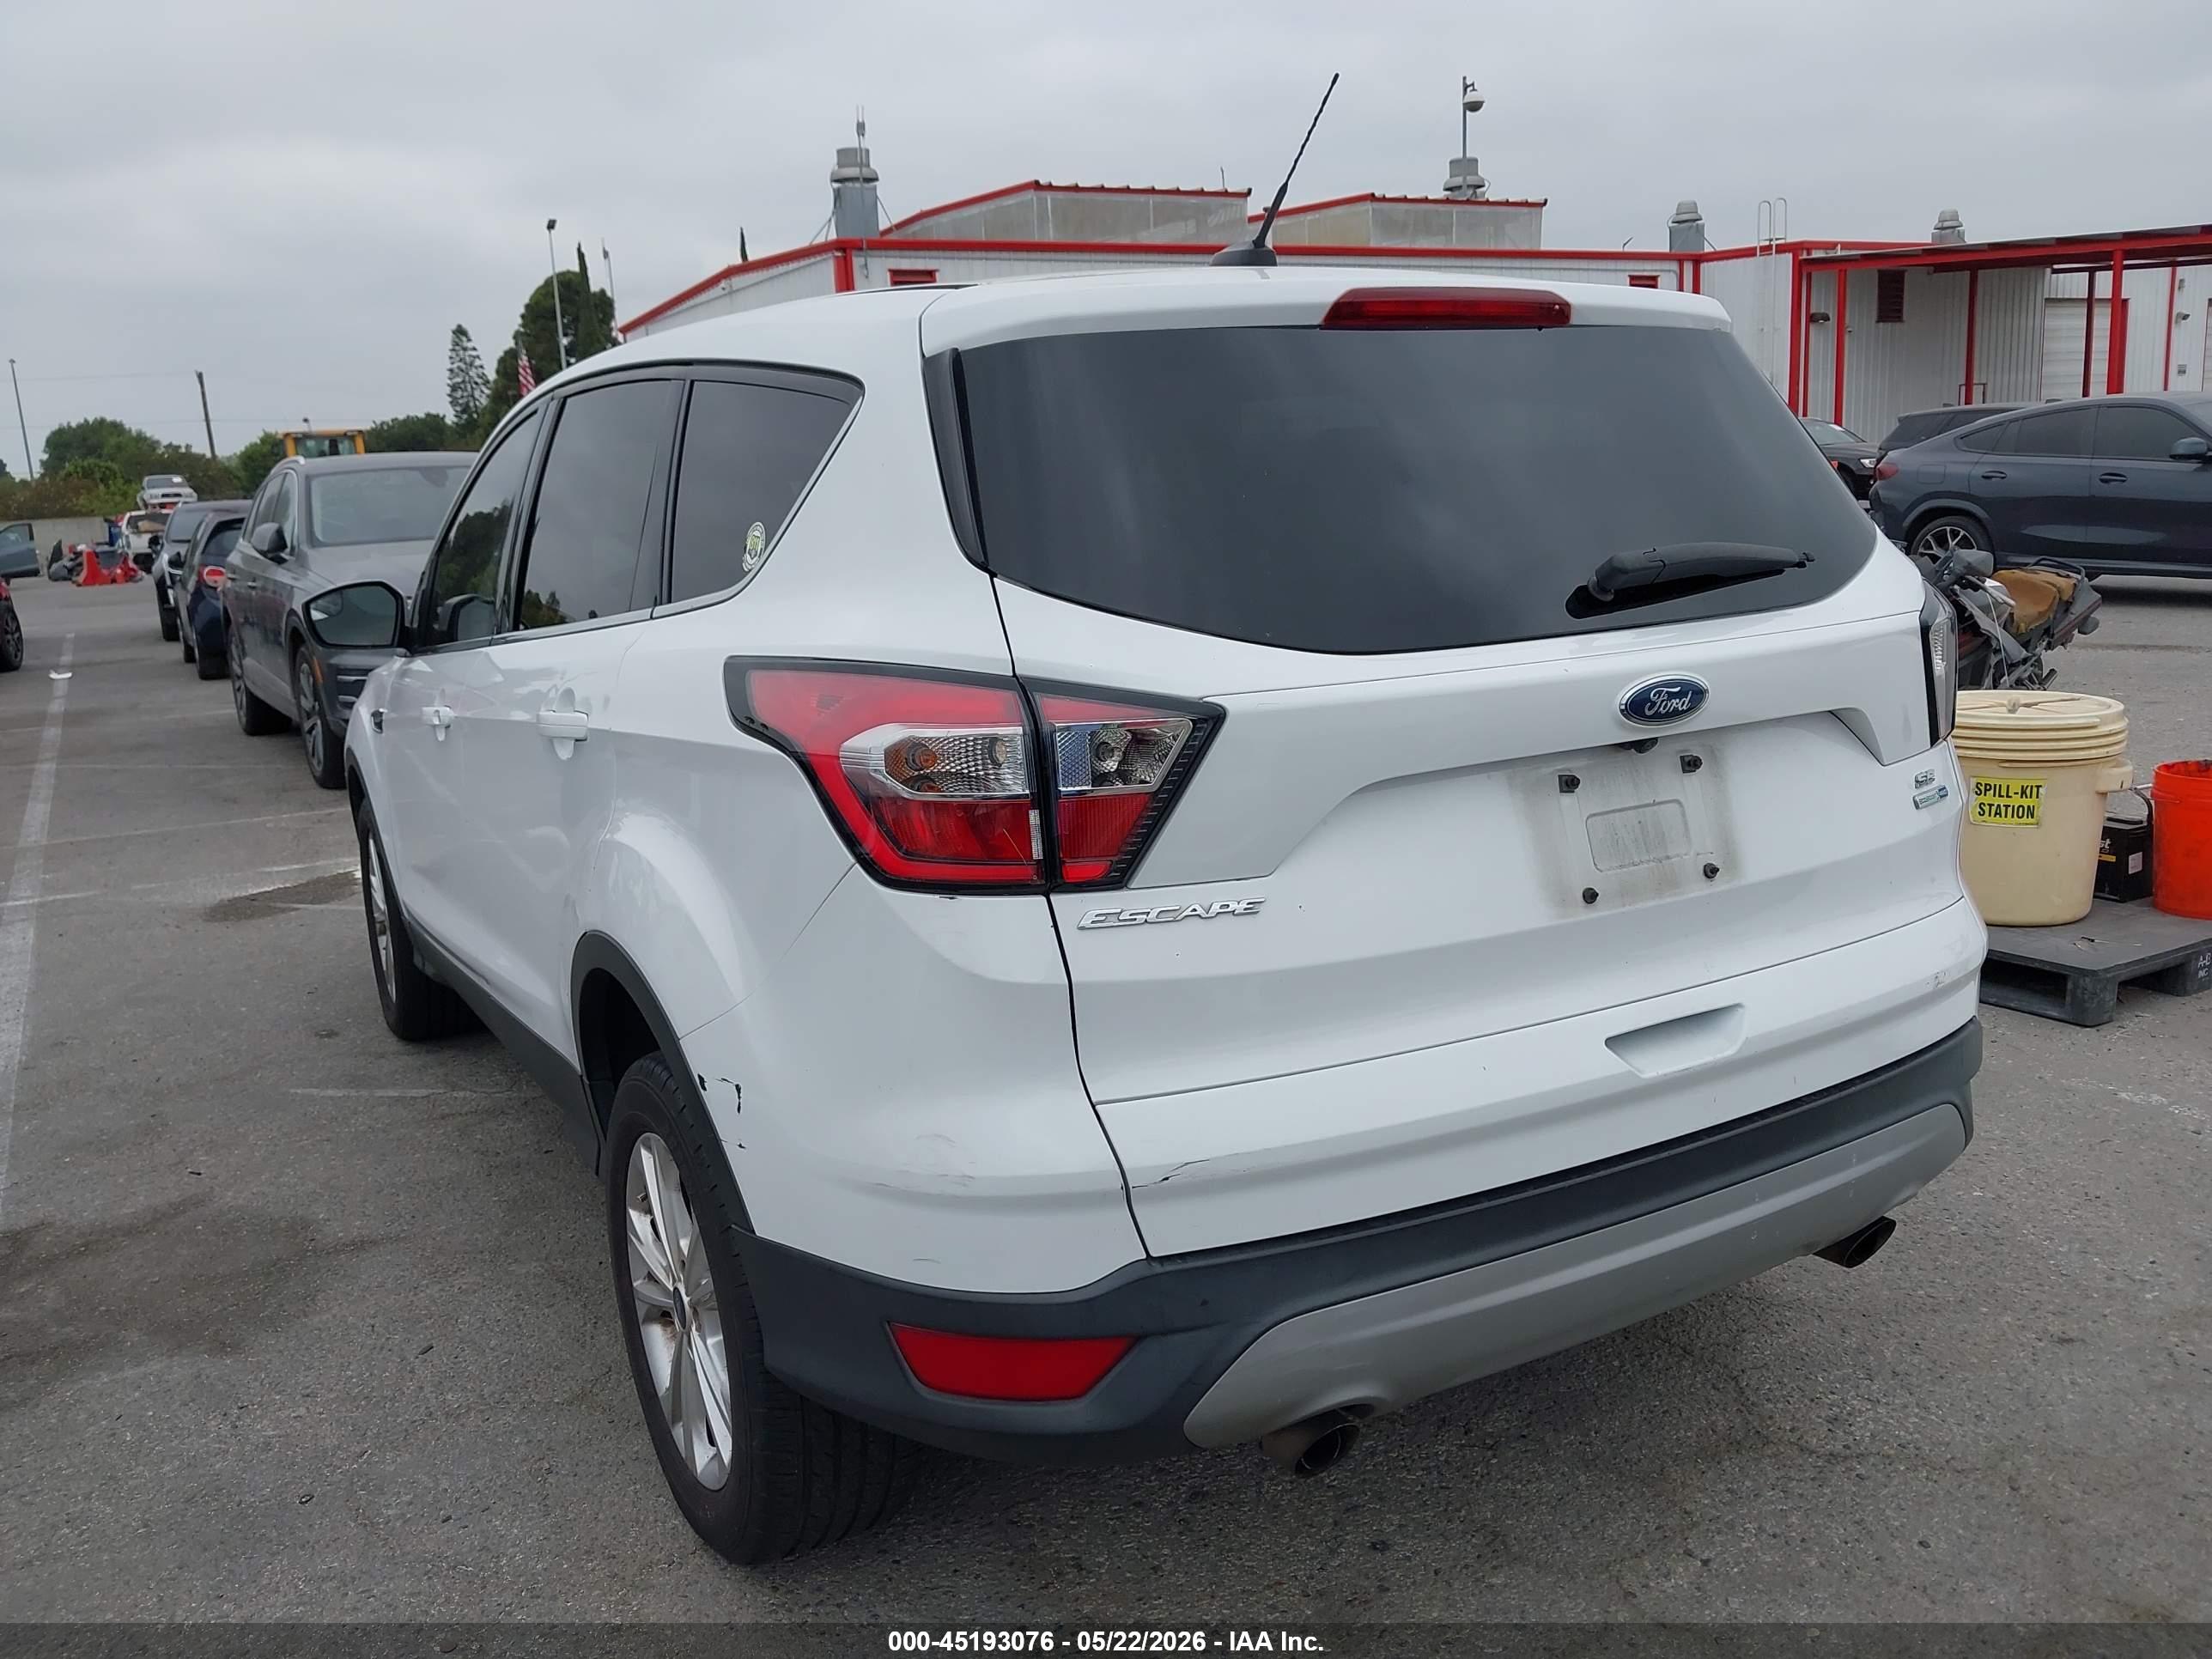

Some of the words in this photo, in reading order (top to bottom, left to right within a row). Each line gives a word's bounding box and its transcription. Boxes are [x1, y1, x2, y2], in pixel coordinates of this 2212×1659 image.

[1645, 687, 1692, 715] Ford
[1975, 781, 2042, 799] SPILL-KIT
[1978, 802, 2035, 819] STATION
[1078, 897, 1266, 930] ESCAPE
